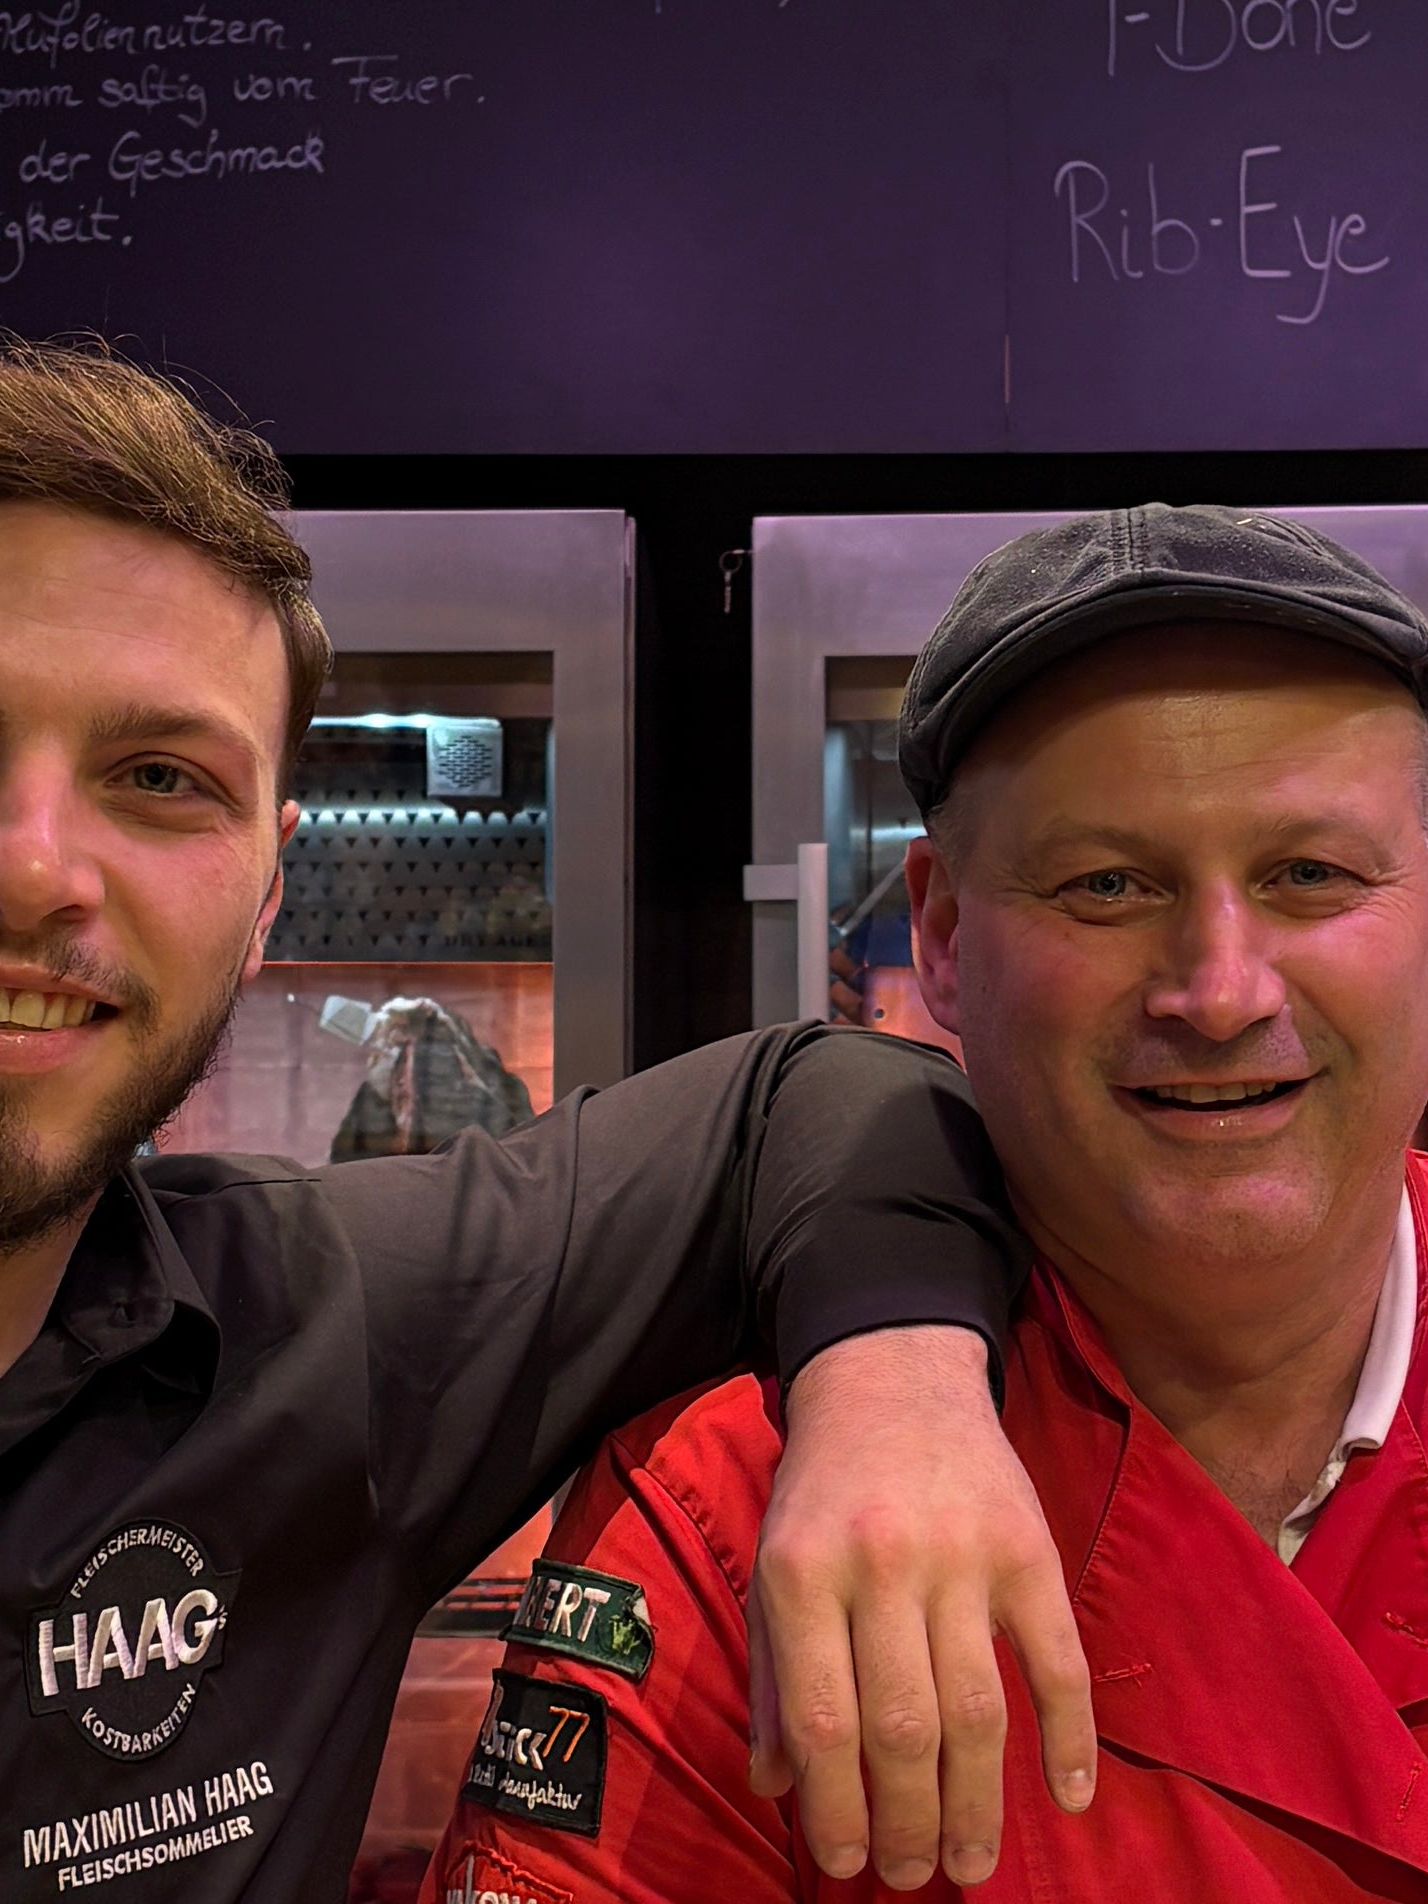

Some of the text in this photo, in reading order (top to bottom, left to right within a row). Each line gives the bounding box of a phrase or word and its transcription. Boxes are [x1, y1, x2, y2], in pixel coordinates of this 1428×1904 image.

[96, 63, 208, 129] saftig
[231, 71, 315, 103] vom
[330, 53, 487, 106] Feuer.
[18, 137, 91, 184] der
[107, 127, 326, 199] Geschmack
[1053, 144, 1391, 325] Rib-Eye
[70, 1525, 205, 1600] FLEISCHERMEISTER
[81, 1682, 197, 1755] KOSTBARKEITEN
[22, 1760, 274, 1869] MAXIMILIAN HAAG
[57, 1814, 254, 1893] FLEISCHSOMMELIER
